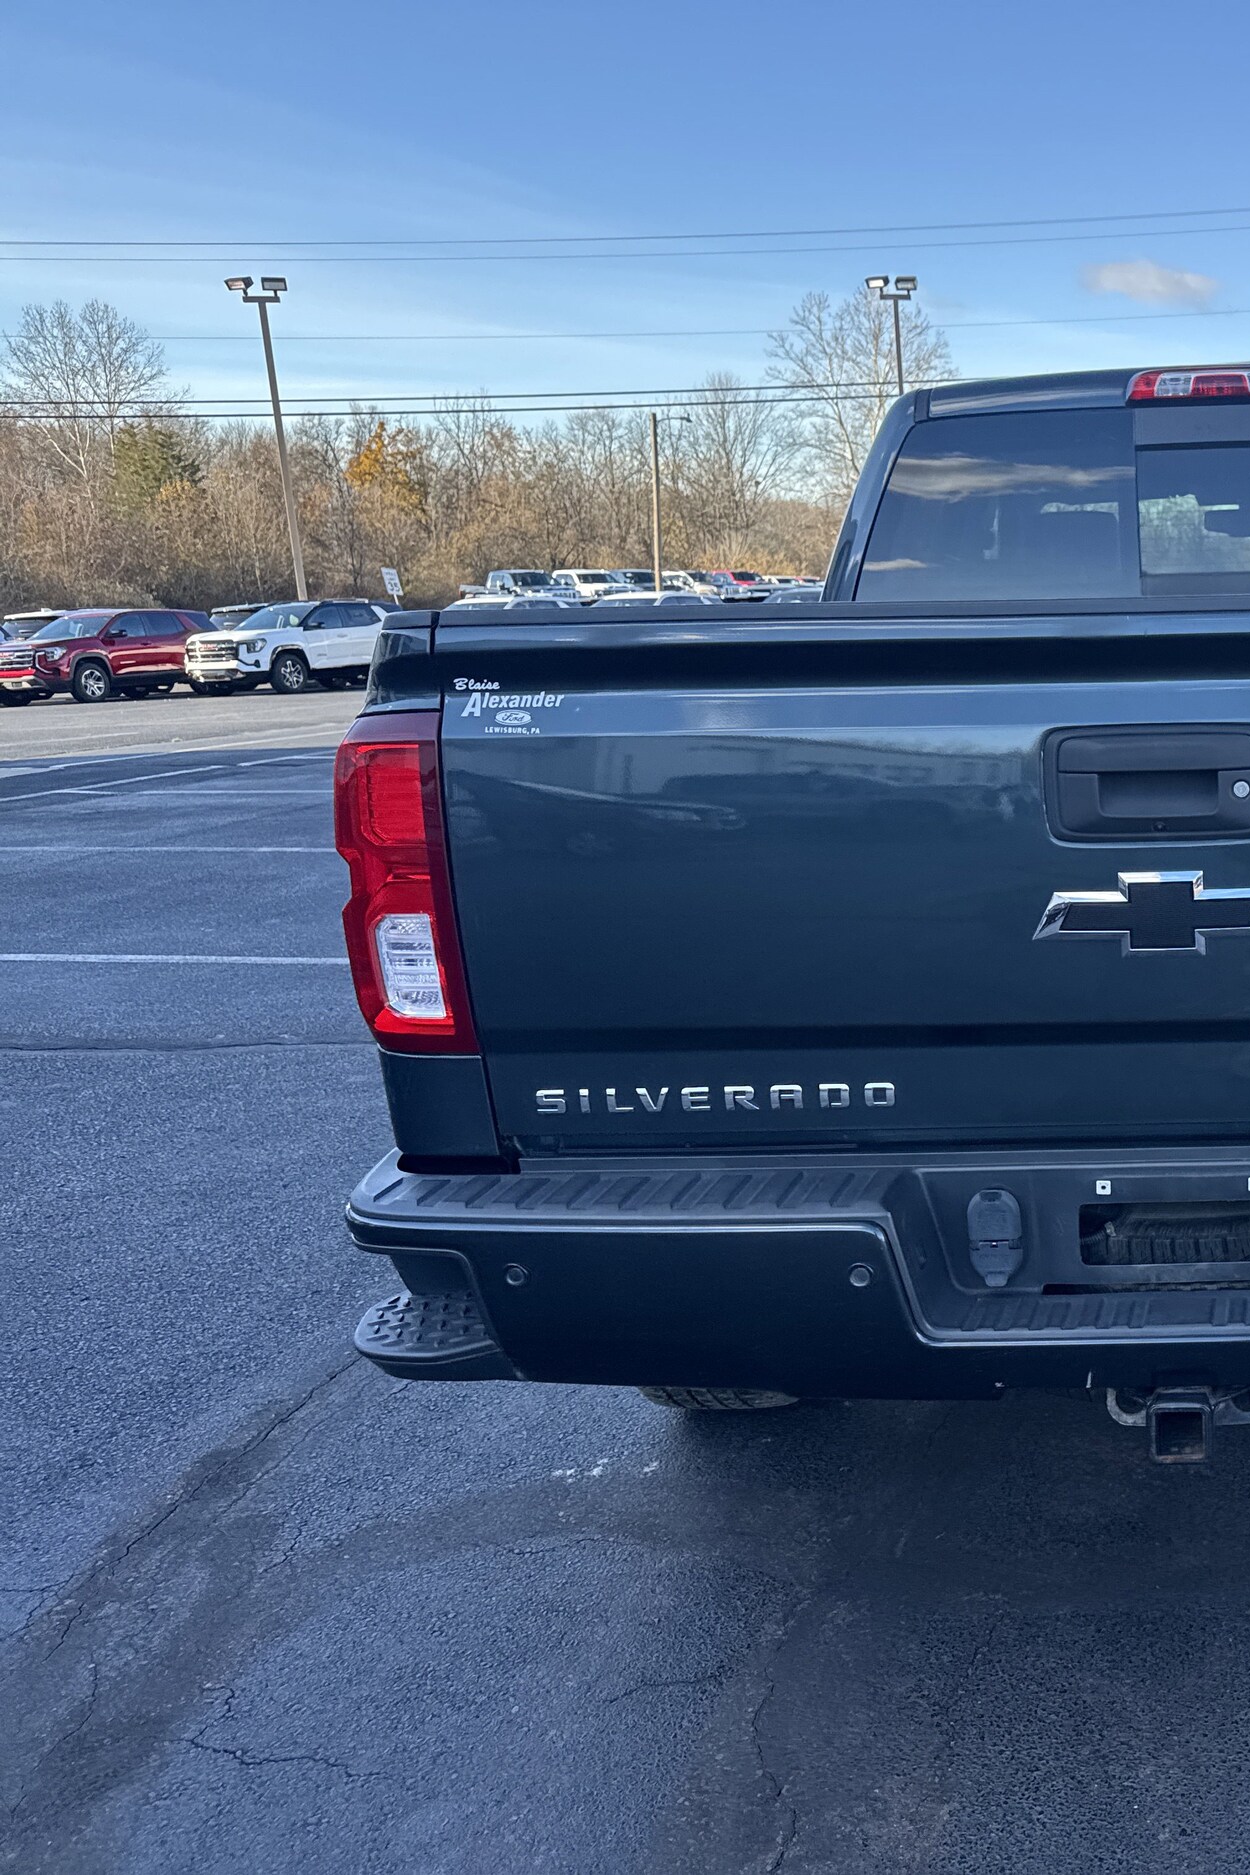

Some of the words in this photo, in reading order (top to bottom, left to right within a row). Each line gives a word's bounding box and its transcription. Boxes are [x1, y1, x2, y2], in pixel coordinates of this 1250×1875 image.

[453, 677, 500, 690] Blaise
[461, 691, 565, 717] Alexander
[498, 711, 528, 722] Ford
[485, 726, 529, 735] LEWISBURG,
[535, 1082, 895, 1114] SILVERADO
